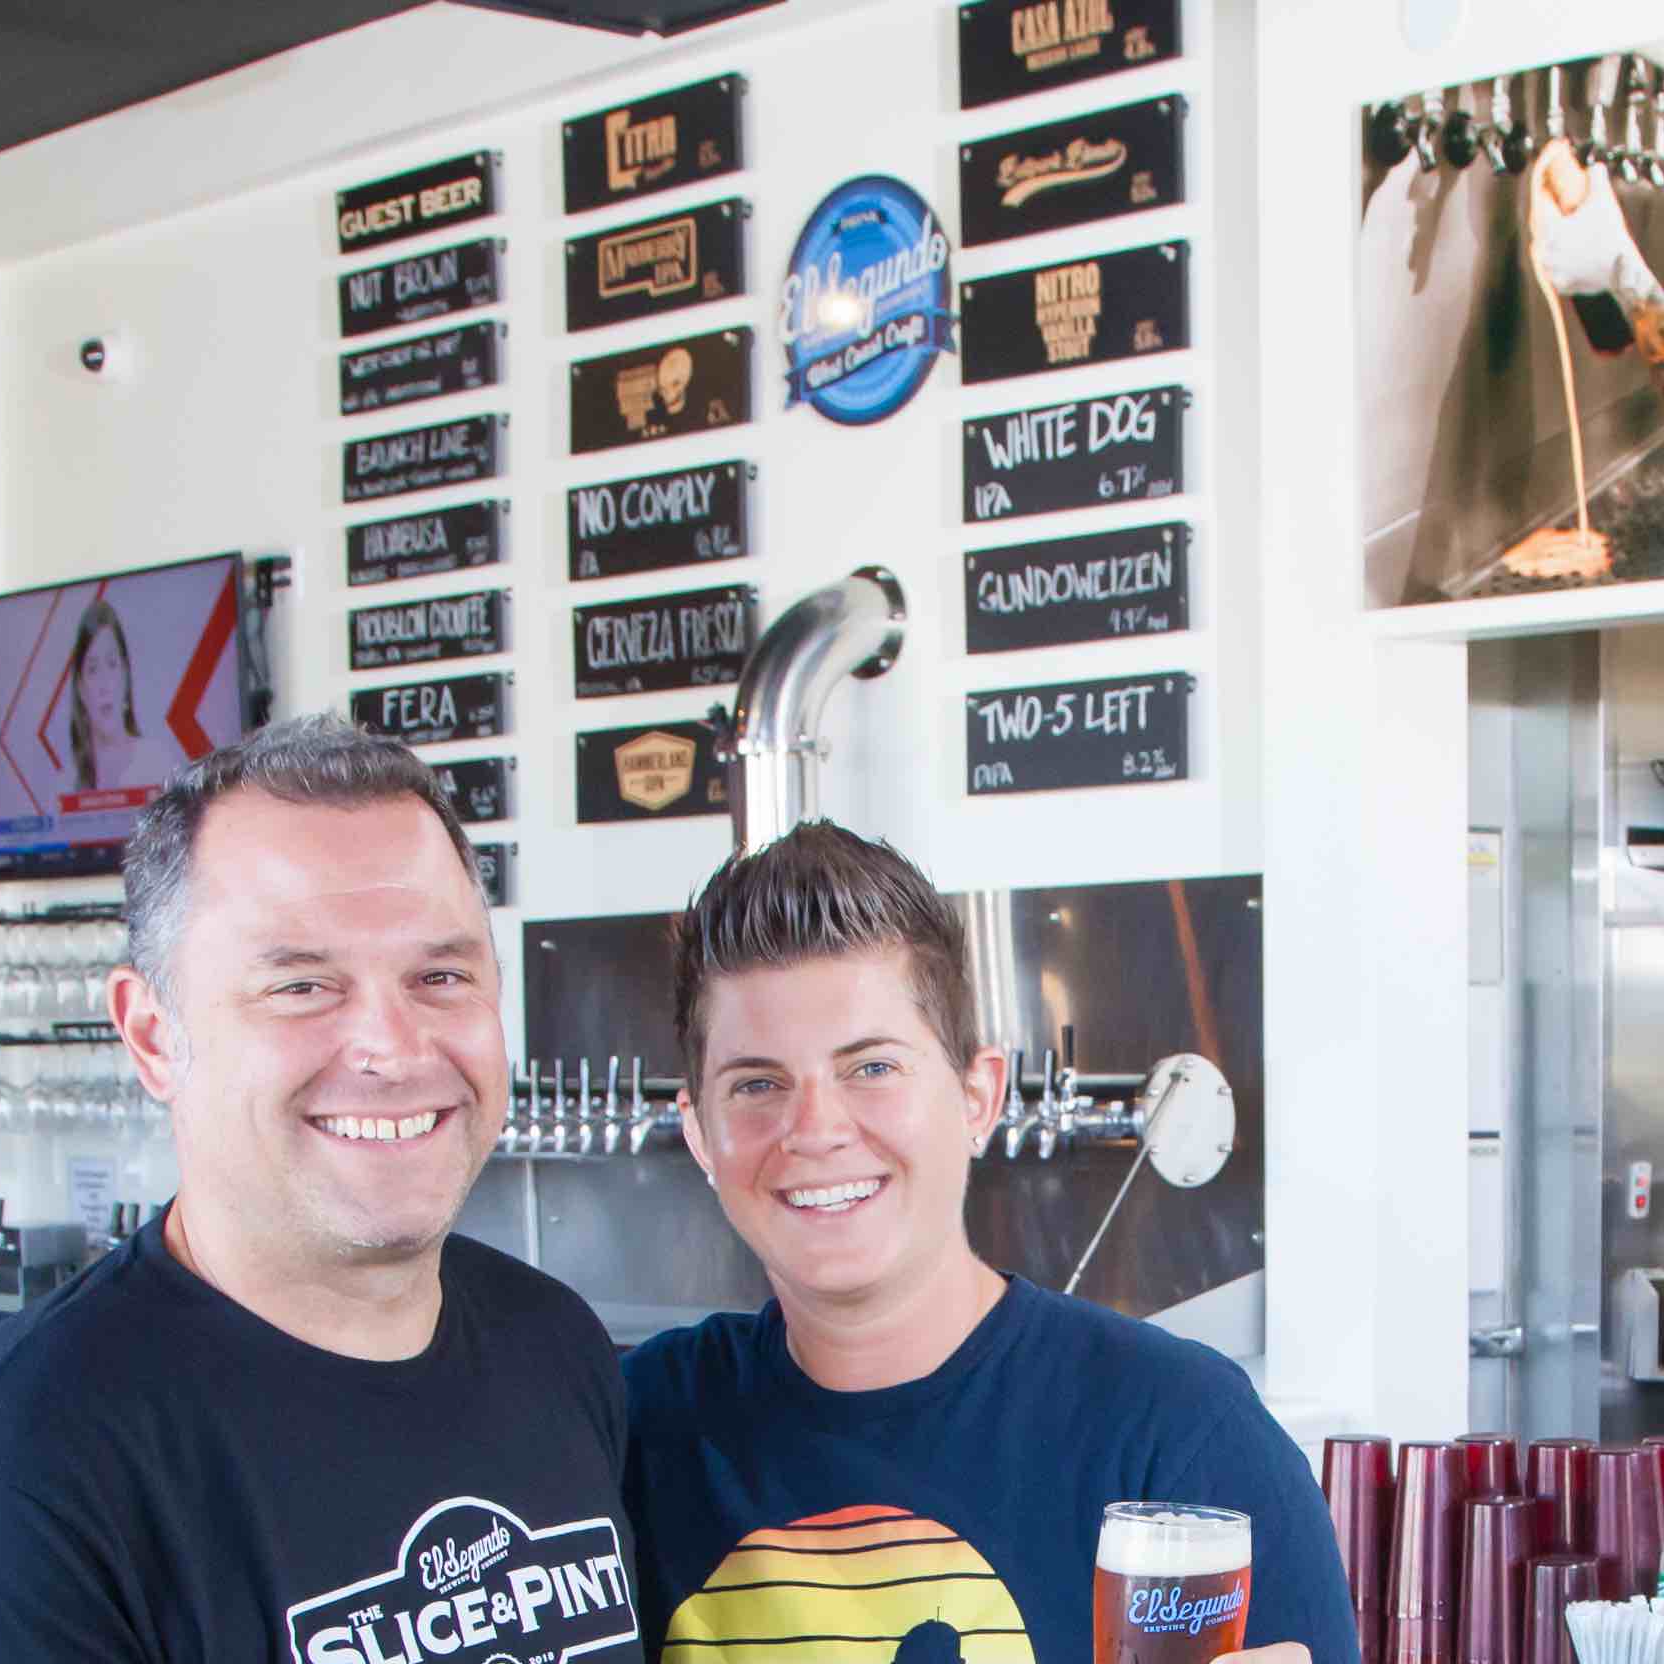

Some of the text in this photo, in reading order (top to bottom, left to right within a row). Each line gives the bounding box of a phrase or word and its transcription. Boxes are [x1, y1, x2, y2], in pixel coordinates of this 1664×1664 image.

[339, 176, 482, 239] GUEST BEER
[1035, 260, 1100, 305] NITRO
[982, 394, 1156, 470] WHITE DOG
[577, 471, 716, 539] NO COMPLY
[974, 481, 1013, 519] IPA
[978, 545, 1172, 613] GUNDOWEIZEN
[588, 608, 675, 669] CERVEZA
[382, 684, 458, 729] FERA
[978, 685, 1154, 744] TWO-5 LEFT
[347, 1603, 384, 1627] THE
